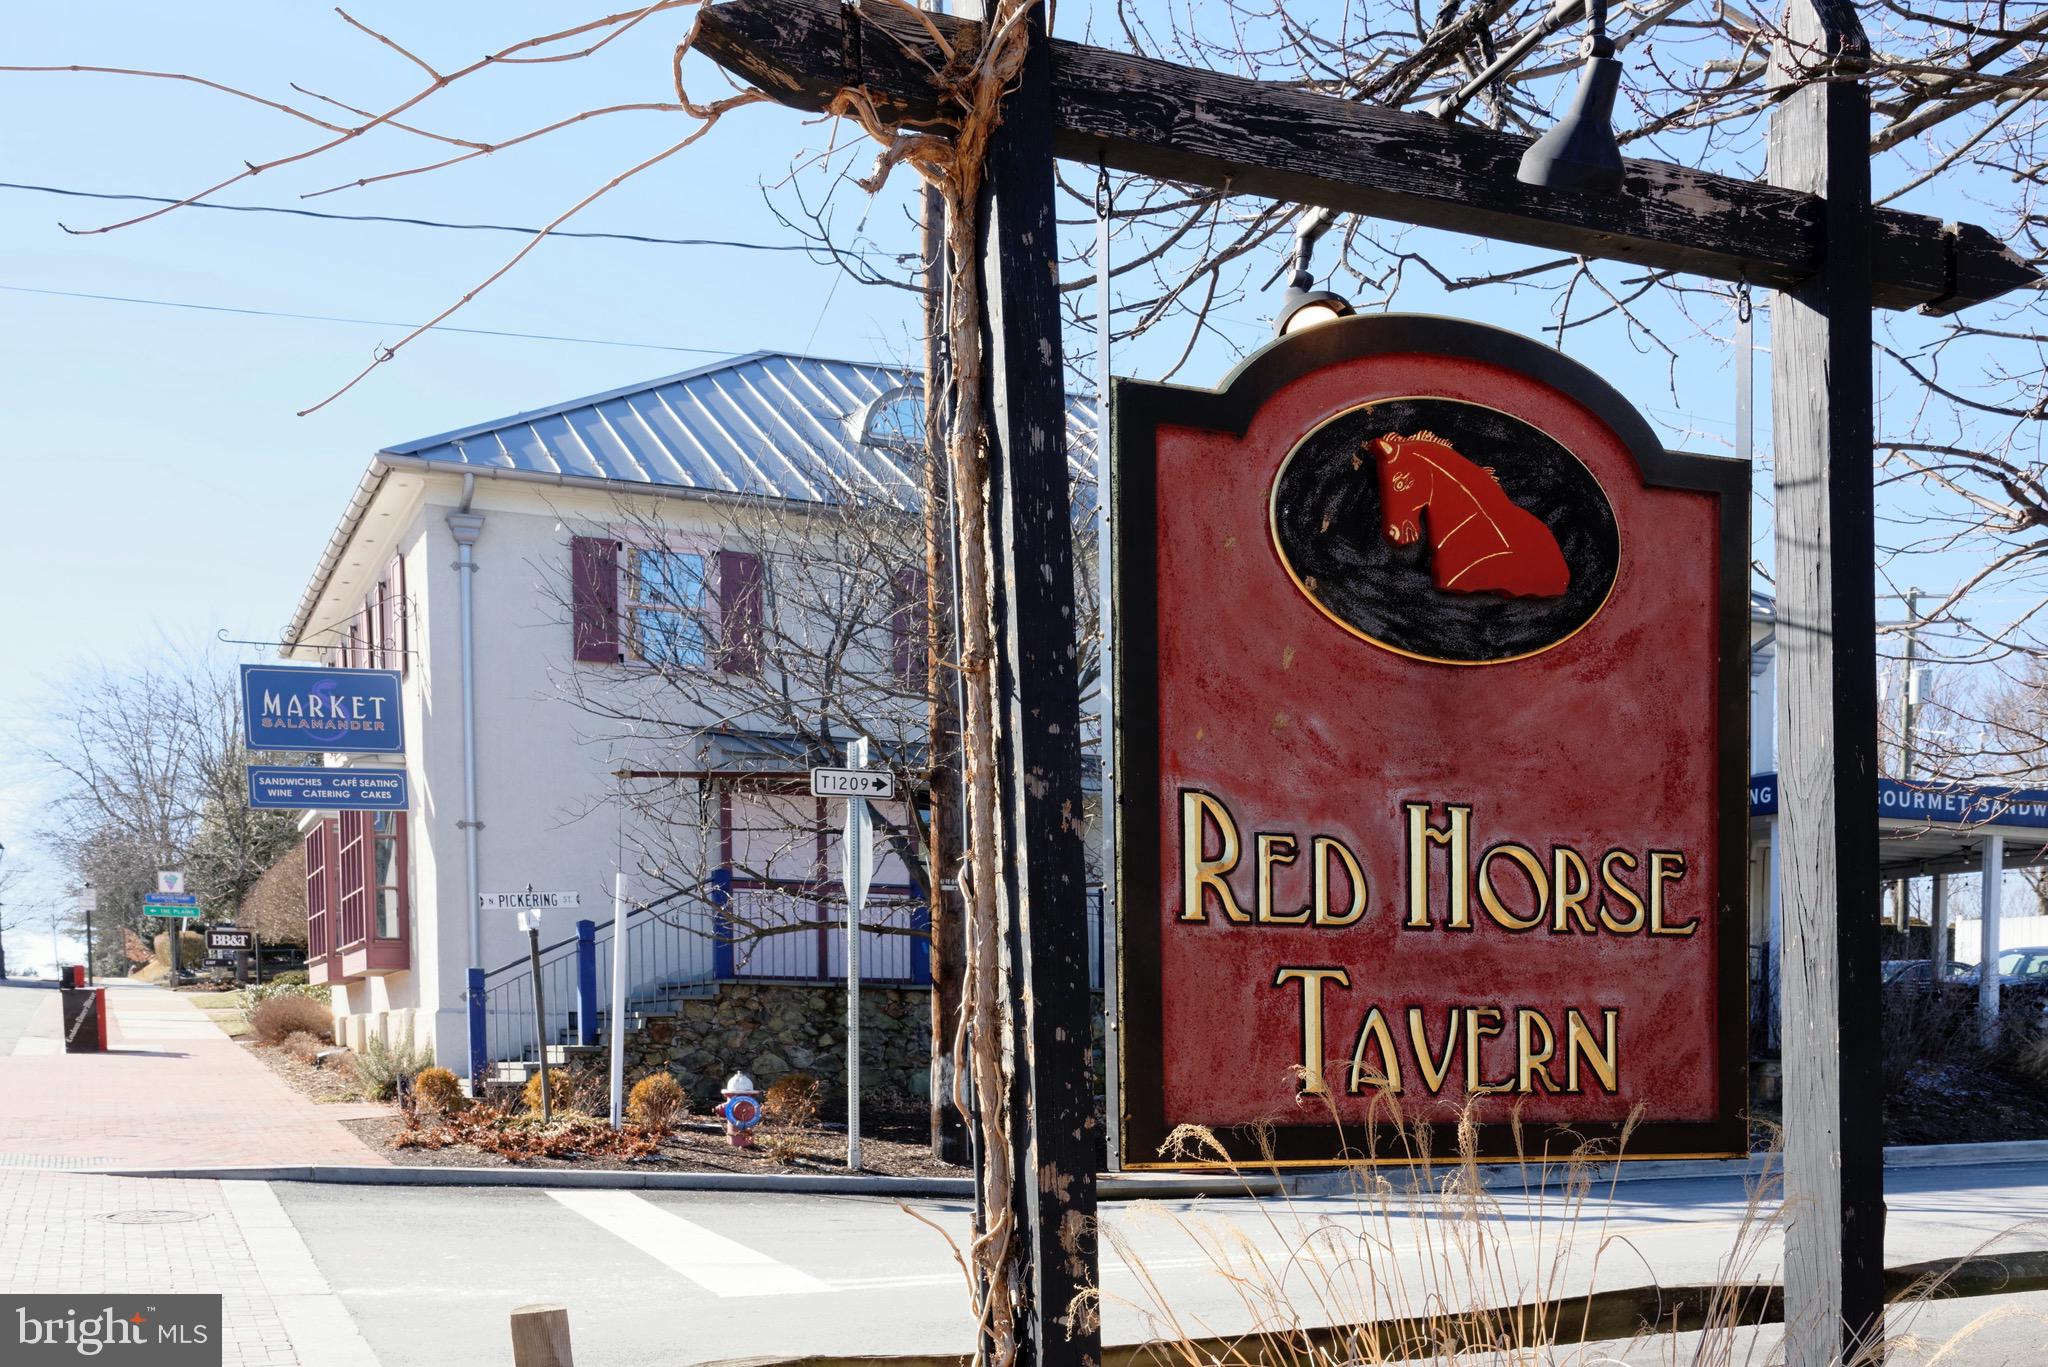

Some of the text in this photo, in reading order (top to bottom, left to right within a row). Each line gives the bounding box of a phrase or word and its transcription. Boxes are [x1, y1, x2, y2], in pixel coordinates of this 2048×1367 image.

[261, 688, 386, 720] MARKET
[261, 717, 385, 731] SALAMANDER
[258, 777, 399, 788] SANDWICHES CAFÉ SEATING
[821, 775, 869, 791] T1209
[267, 788, 392, 799] WINE CATERING CAKES
[1877, 790, 1970, 812] OURMET
[1178, 788, 1700, 936] RED HORSE
[498, 893, 558, 908] PICKERING
[211, 934, 249, 947] BB&T
[1273, 966, 1621, 1095] TAVERN
